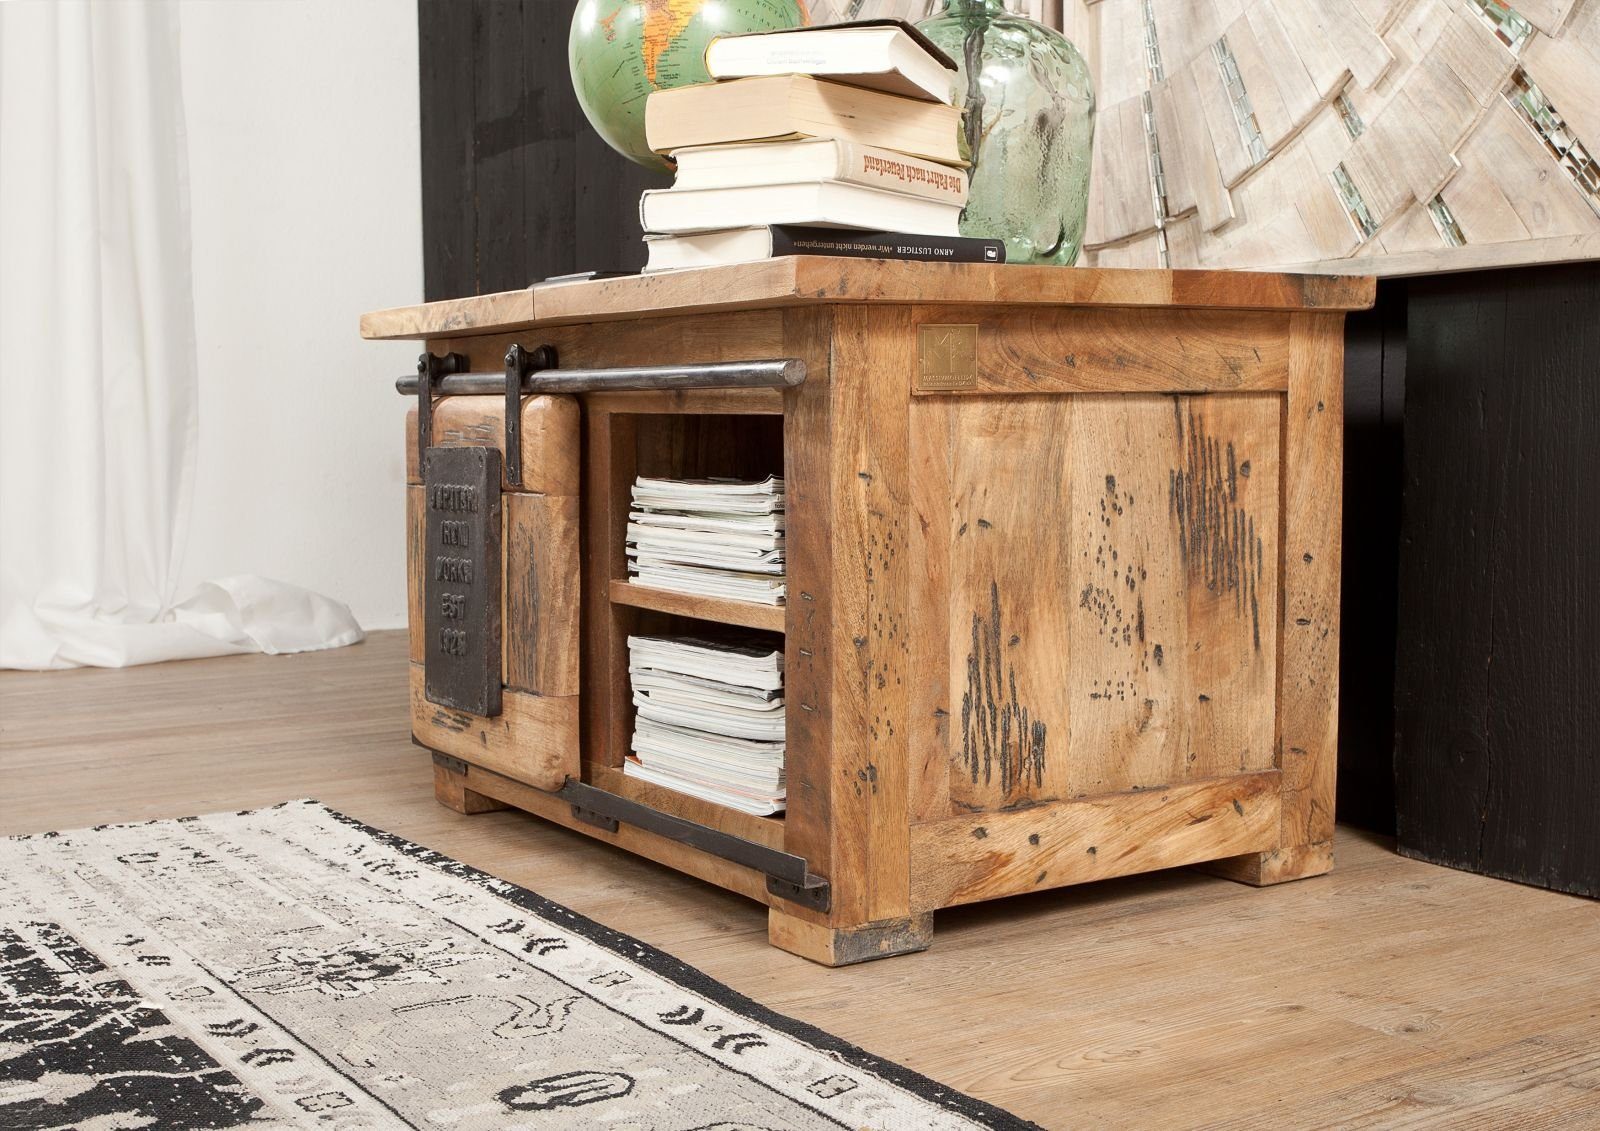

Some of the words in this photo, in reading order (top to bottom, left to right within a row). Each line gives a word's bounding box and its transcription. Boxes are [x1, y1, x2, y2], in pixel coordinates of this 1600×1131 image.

[863, 155, 905, 181] Feuerland
[906, 165, 926, 183] nach
[926, 169, 948, 190] Fahrt
[948, 176, 962, 194] Die
[835, 242, 852, 251] nicht
[853, 243, 877, 252] werden
[897, 246, 932, 255] LUSTIGER
[934, 247, 954, 256] ARNO
[441, 592, 465, 619] EST
